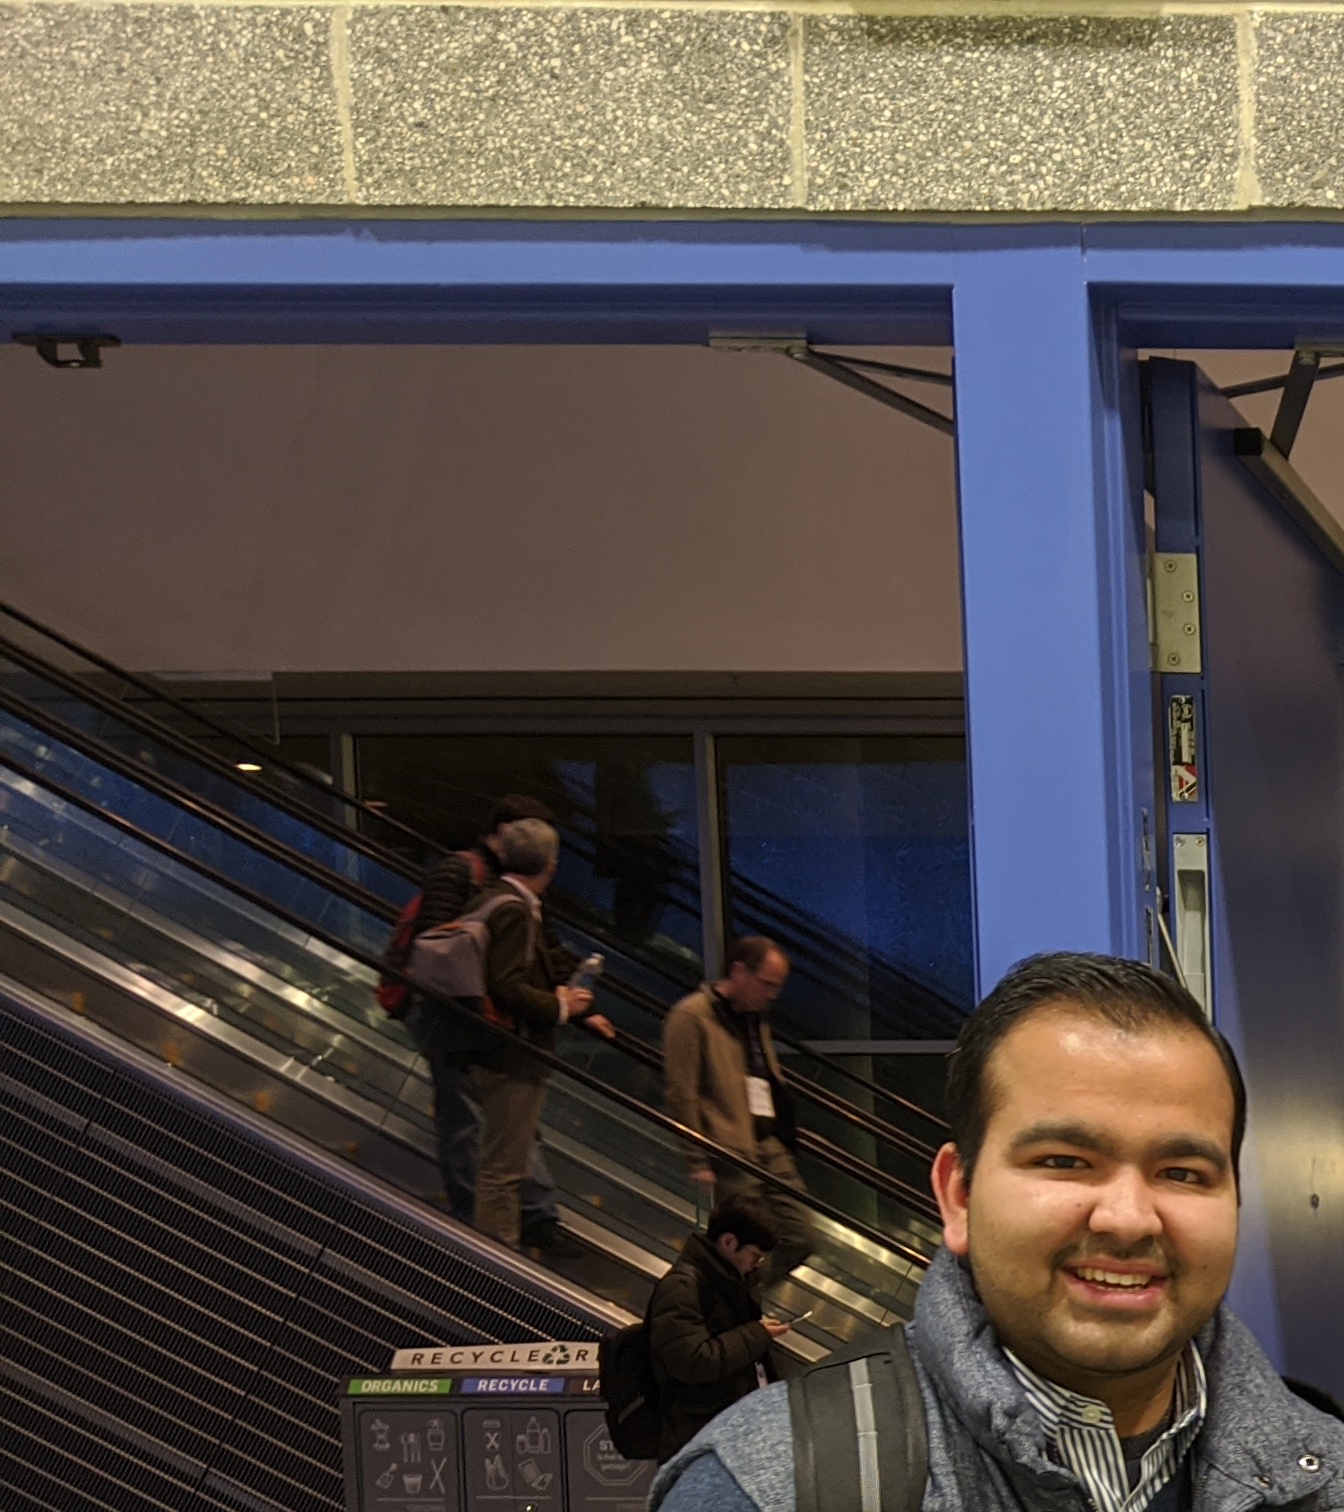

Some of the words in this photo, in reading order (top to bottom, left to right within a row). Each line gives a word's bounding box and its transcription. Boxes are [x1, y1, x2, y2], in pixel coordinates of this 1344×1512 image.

[411, 1350, 540, 1365] RECYCLE
[361, 1379, 439, 1393] ORGANICS
[477, 1379, 549, 1392] RECYCLE
